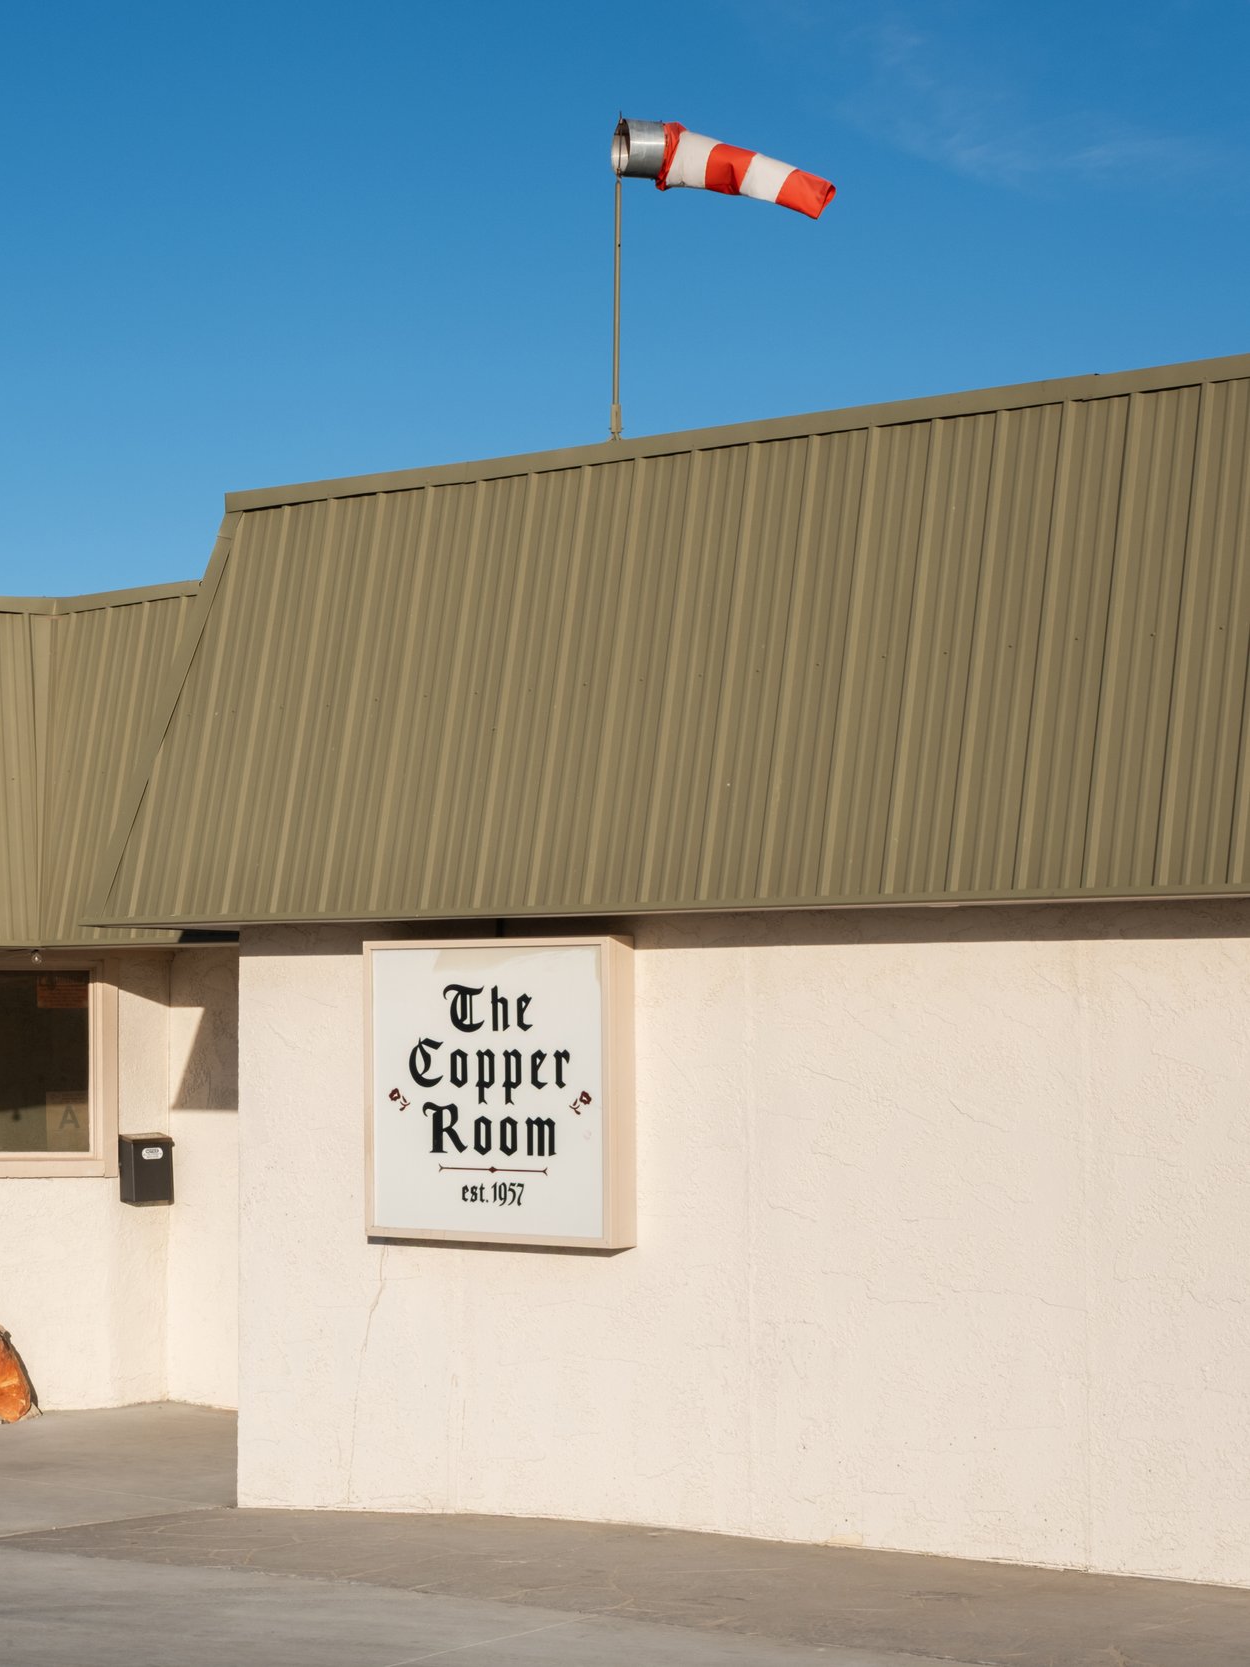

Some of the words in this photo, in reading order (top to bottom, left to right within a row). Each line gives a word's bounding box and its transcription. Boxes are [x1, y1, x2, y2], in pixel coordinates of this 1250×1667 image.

[442, 983, 534, 1033] The
[408, 1037, 571, 1106] Copper
[58, 1104, 81, 1129] A
[422, 1101, 557, 1157] Room
[461, 1183, 489, 1203] est.
[491, 1182, 525, 1207] 1957
